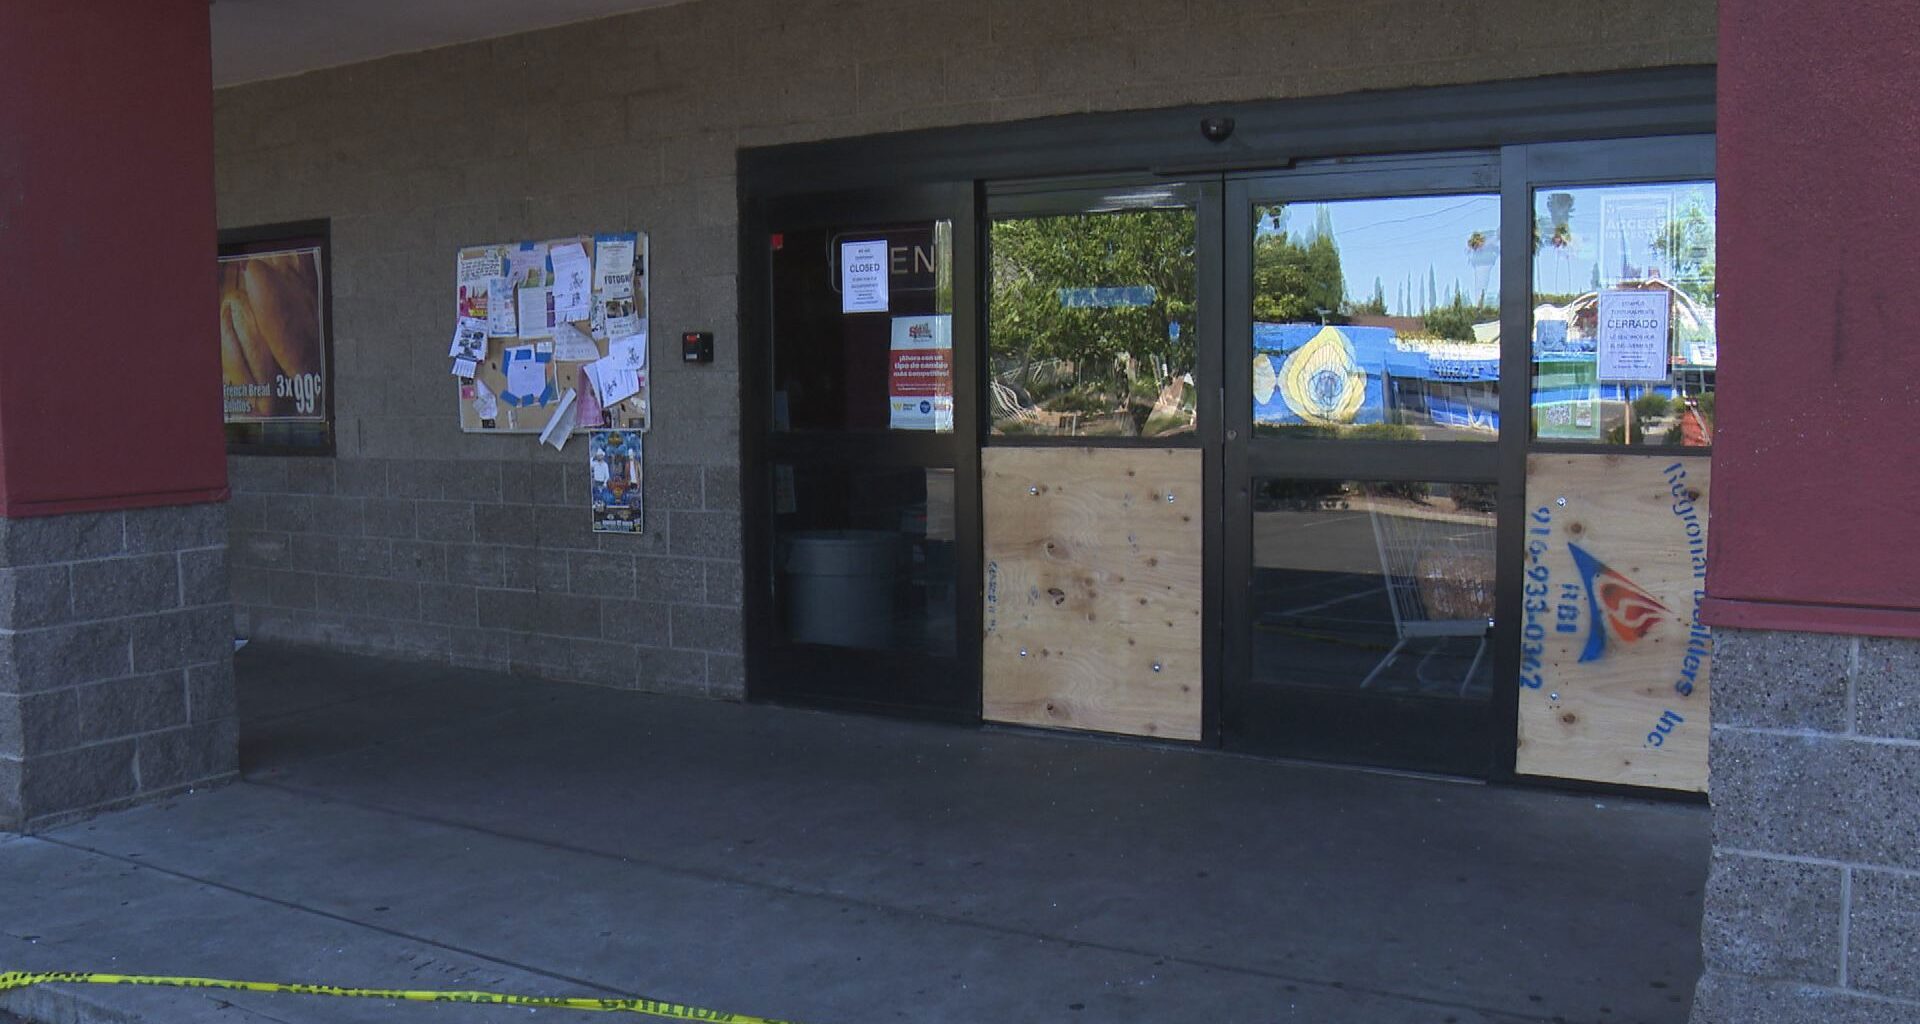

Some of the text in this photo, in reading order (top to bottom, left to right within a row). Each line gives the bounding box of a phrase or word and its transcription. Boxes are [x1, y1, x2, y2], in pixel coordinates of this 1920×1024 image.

[890, 245, 935, 274] EN
[849, 263, 880, 273] CLOSED
[1607, 319, 1659, 329] CERRADO
[248, 383, 270, 396] Bread
[1556, 583, 1581, 634] RBI
